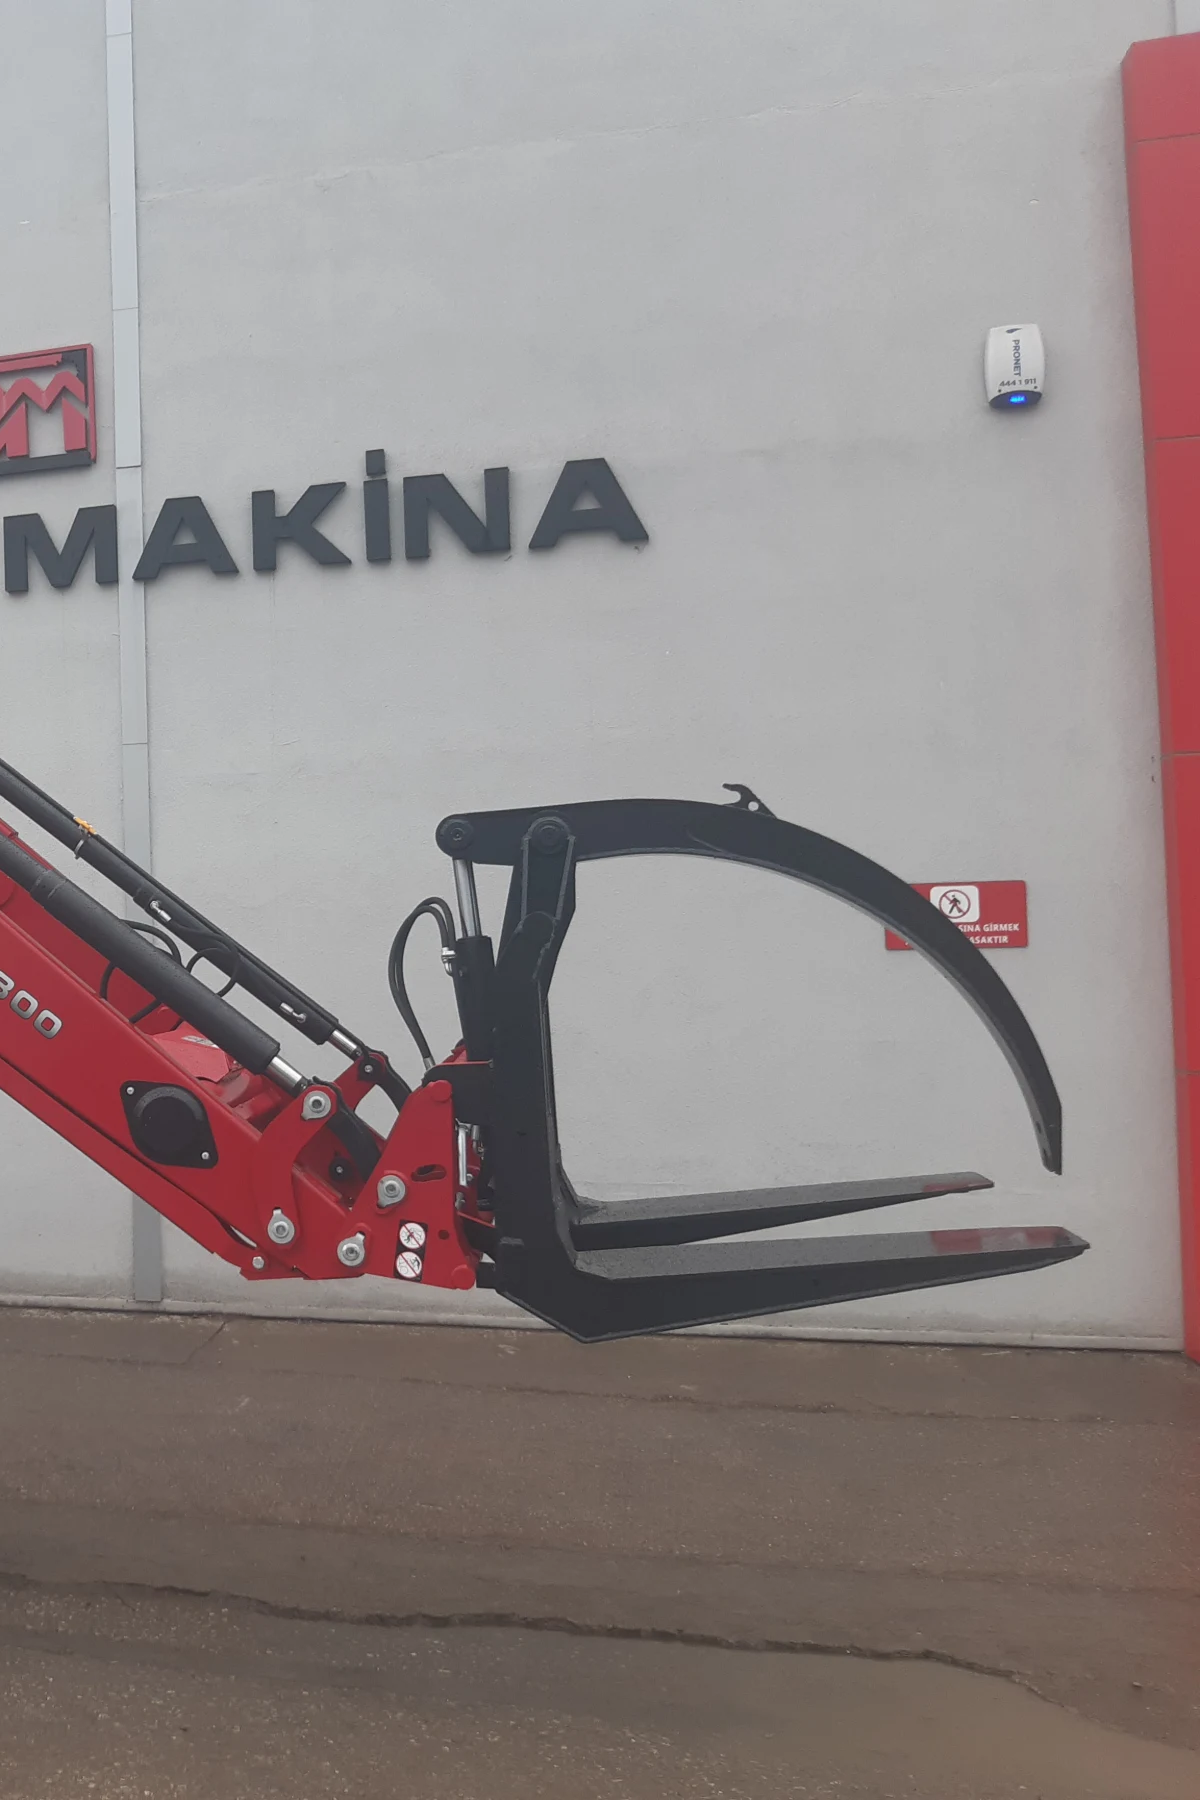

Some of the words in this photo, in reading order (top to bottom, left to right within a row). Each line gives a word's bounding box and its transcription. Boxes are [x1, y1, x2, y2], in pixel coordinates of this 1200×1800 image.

[1012, 339, 1022, 377] PRONET
[3, 449, 649, 594] MAKİNA
[957, 924, 981, 932] SINA
[983, 922, 1020, 932] GİRMEK
[967, 935, 1009, 944] ASAKTIR
